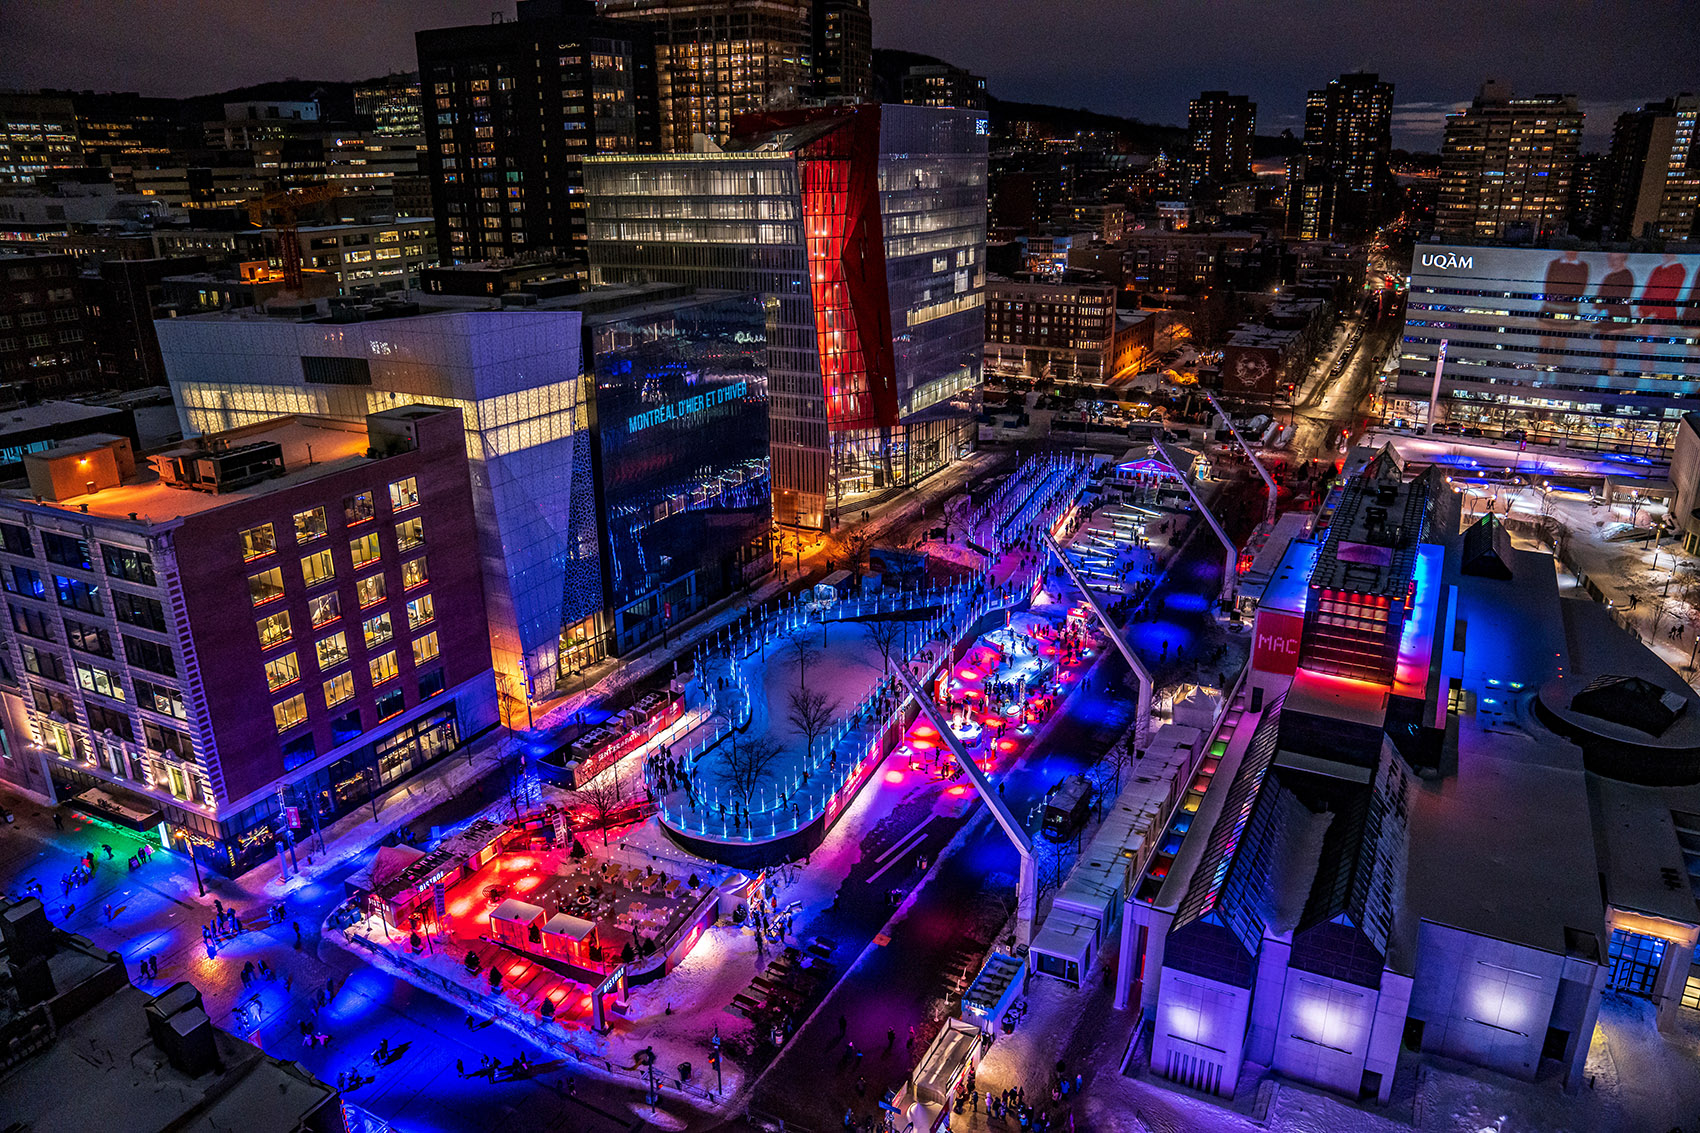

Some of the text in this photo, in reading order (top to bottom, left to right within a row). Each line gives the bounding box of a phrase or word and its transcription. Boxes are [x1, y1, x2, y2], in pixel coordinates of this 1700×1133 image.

[1422, 252, 1473, 270] UQÀM
[628, 381, 747, 434] MONTRÉAL D'HIER ET D'HIVER
[1258, 634, 1298, 655] MAC
